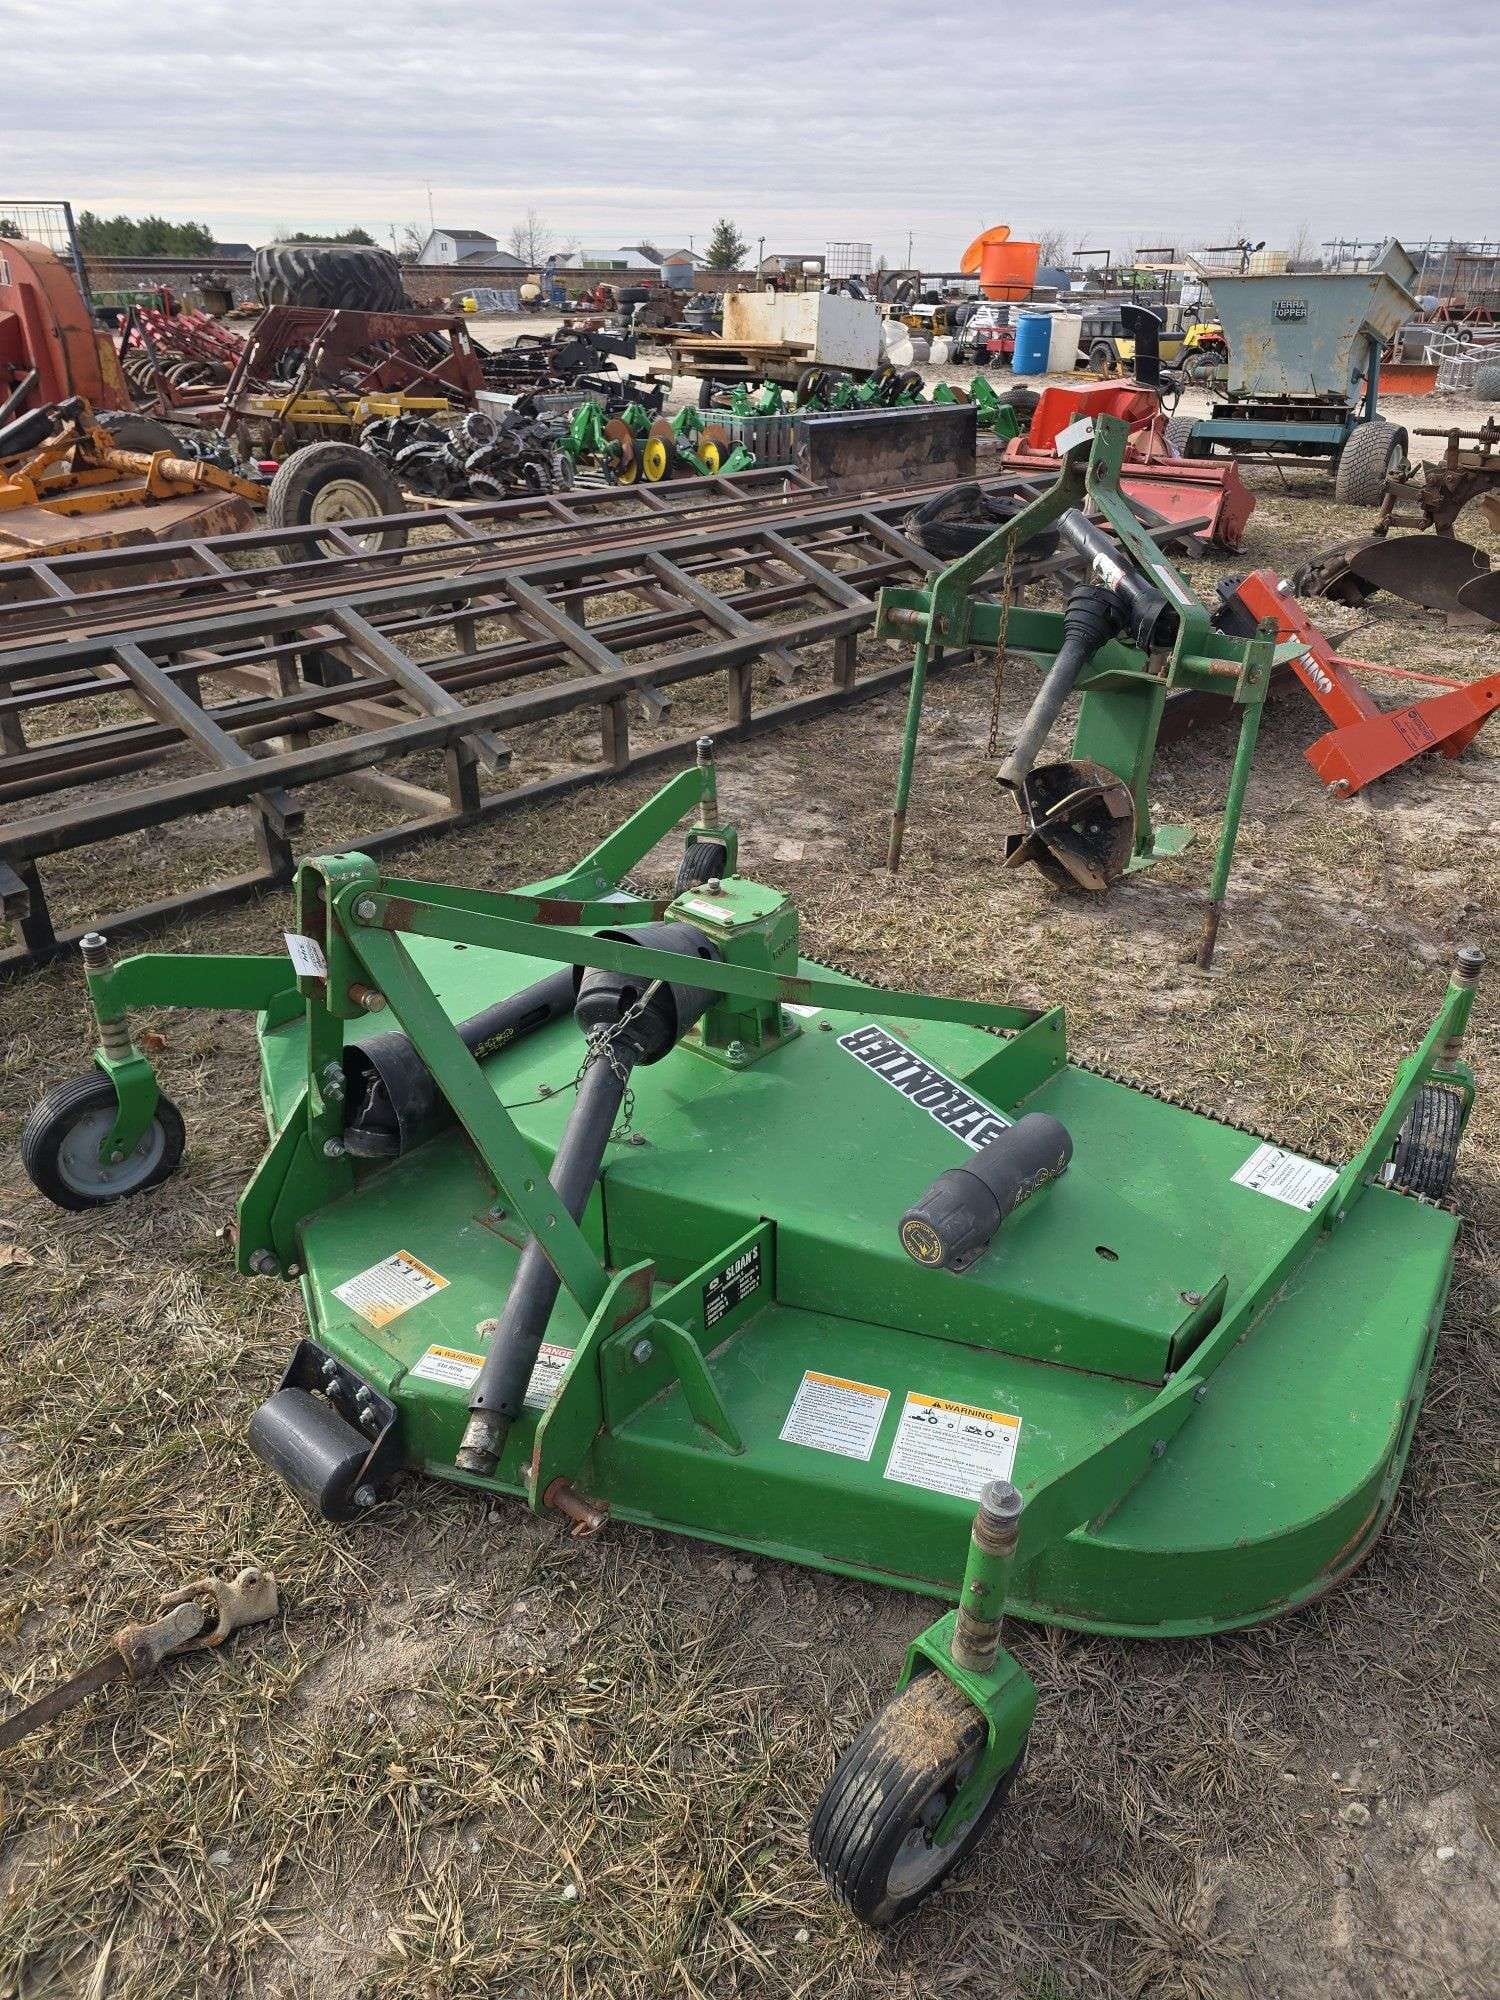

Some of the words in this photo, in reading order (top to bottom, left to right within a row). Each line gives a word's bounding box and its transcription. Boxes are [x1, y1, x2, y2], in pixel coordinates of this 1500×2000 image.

[1274, 309, 1307, 317] TOPPER
[839, 1027, 980, 1140] FRONTIER
[873, 1031, 990, 1116] EQUIPMENT
[726, 1246, 758, 1281] SLOAN'S
[444, 1351, 481, 1365] WARNING
[944, 1403, 994, 1420] WARNING
